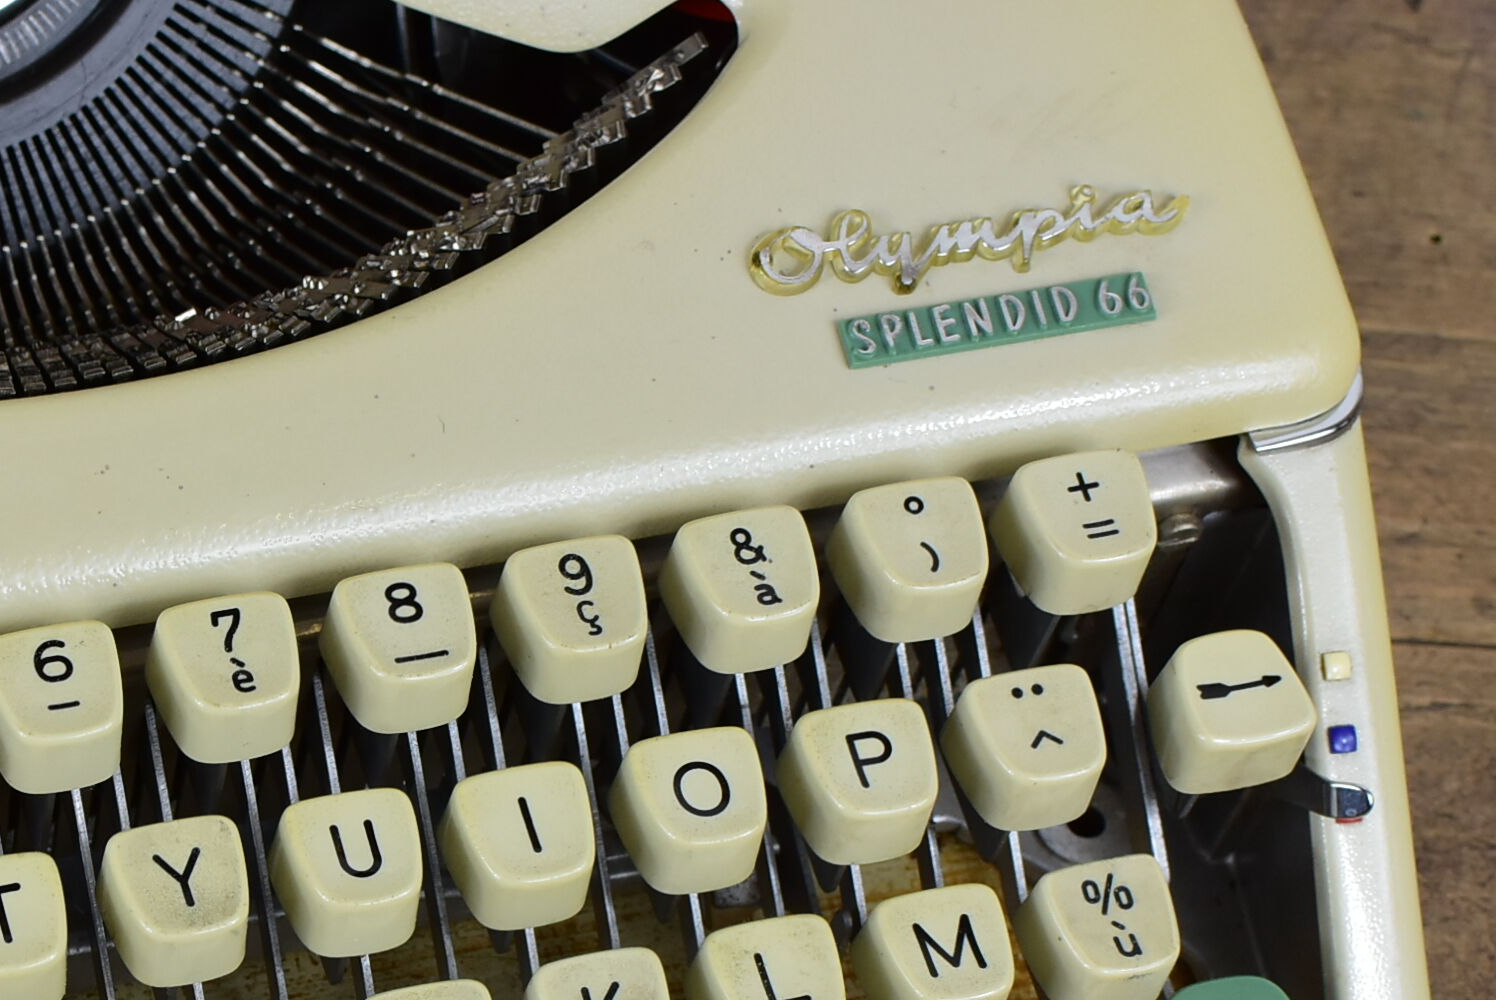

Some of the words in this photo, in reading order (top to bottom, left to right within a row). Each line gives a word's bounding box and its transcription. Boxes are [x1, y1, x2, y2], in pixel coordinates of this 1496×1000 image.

[747, 184, 1191, 296] Olympia
[848, 284, 1081, 357] SPLENDID
[1096, 273, 1151, 317] 66
[1067, 471, 1100, 502] +
[729, 527, 768, 566] &
[1082, 518, 1120, 539] =
[558, 553, 593, 596] 9
[920, 541, 940, 573] )
[384, 582, 424, 624] 8
[749, 570, 783, 606] à
[210, 607, 241, 653] 7
[576, 600, 603, 636] ç
[33, 639, 74, 683] 6
[229, 657, 257, 693] è
[845, 730, 893, 789] P
[672, 761, 731, 817] O
[517, 796, 543, 853] I
[328, 819, 383, 879] U
[152, 846, 201, 908] Y
[1081, 873, 1134, 916] %
[912, 913, 988, 978] M
[1111, 920, 1142, 958] ù
